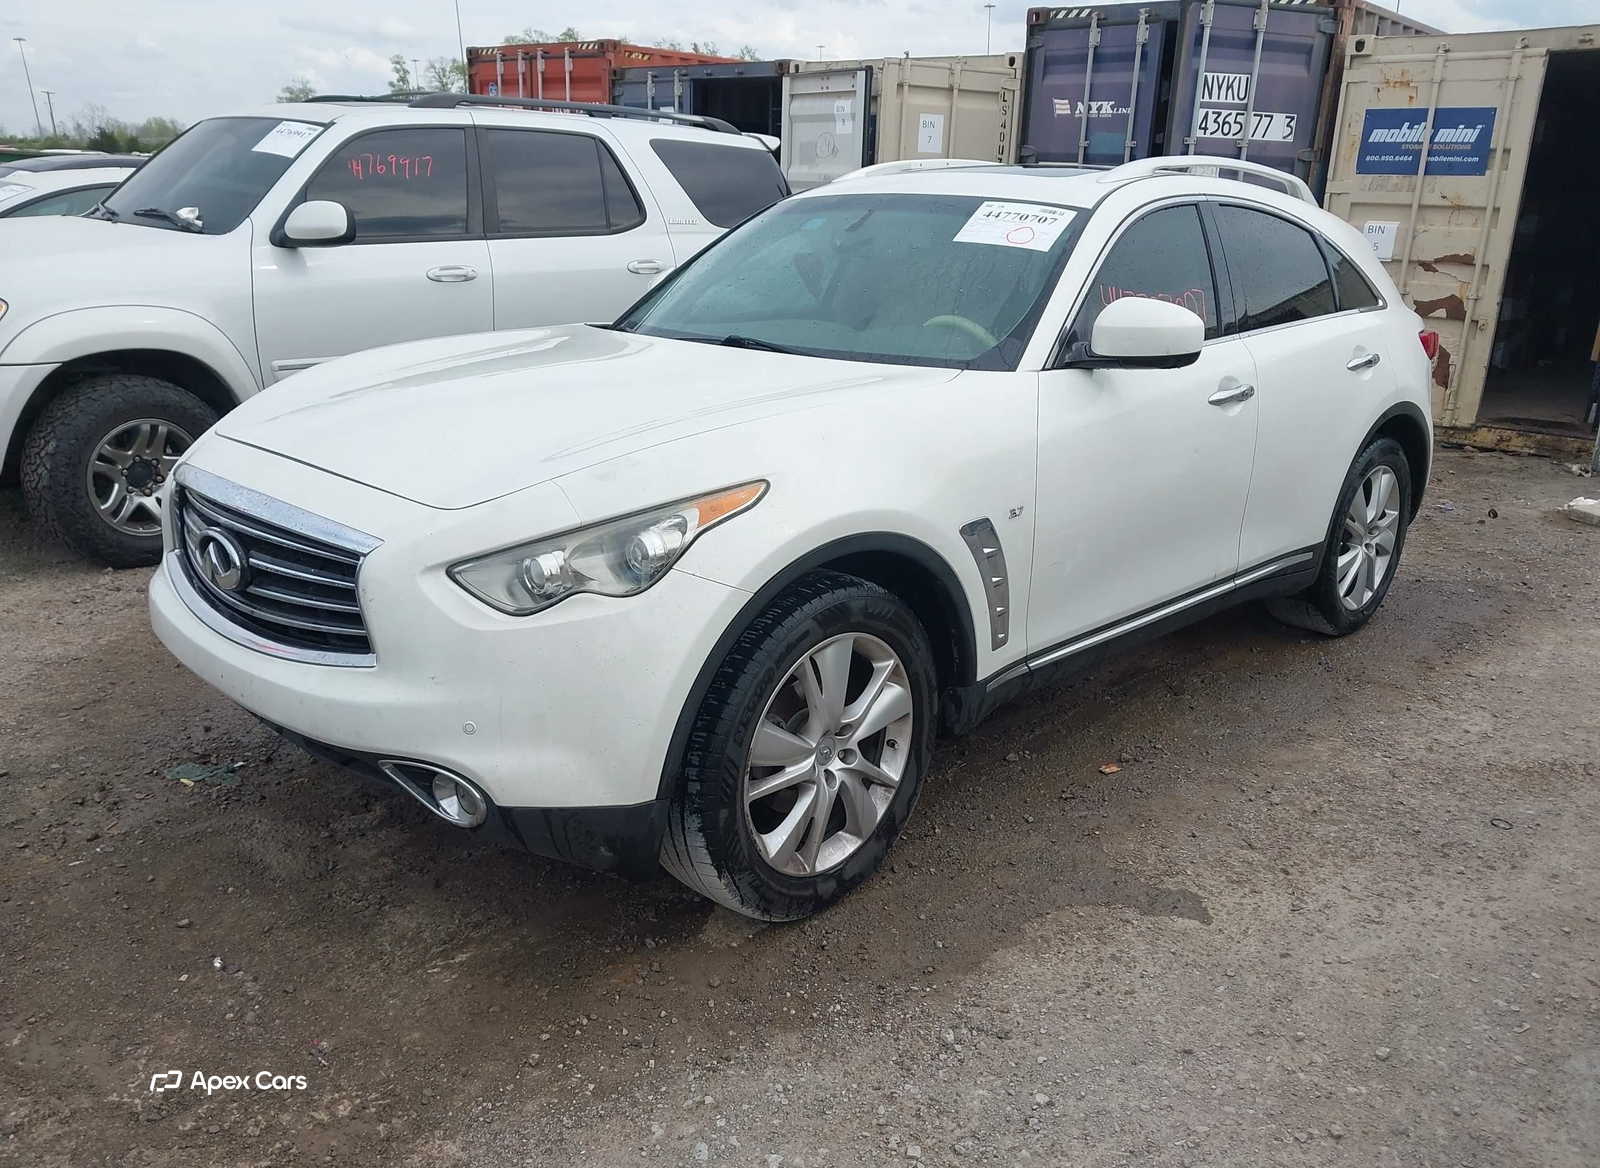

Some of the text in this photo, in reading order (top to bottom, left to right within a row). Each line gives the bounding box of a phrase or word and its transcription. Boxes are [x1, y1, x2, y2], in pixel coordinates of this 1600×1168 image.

[1201, 74, 1250, 101] NYKU
[1074, 101, 1115, 114] NYK
[922, 119, 936, 129] BIN
[1281, 115, 1296, 140] 3
[927, 135, 933, 144] 7
[1433, 124, 1482, 143] mini
[982, 209, 1059, 226] 44770707
[1367, 225, 1386, 234] BIN
[1373, 242, 1379, 251] 5
